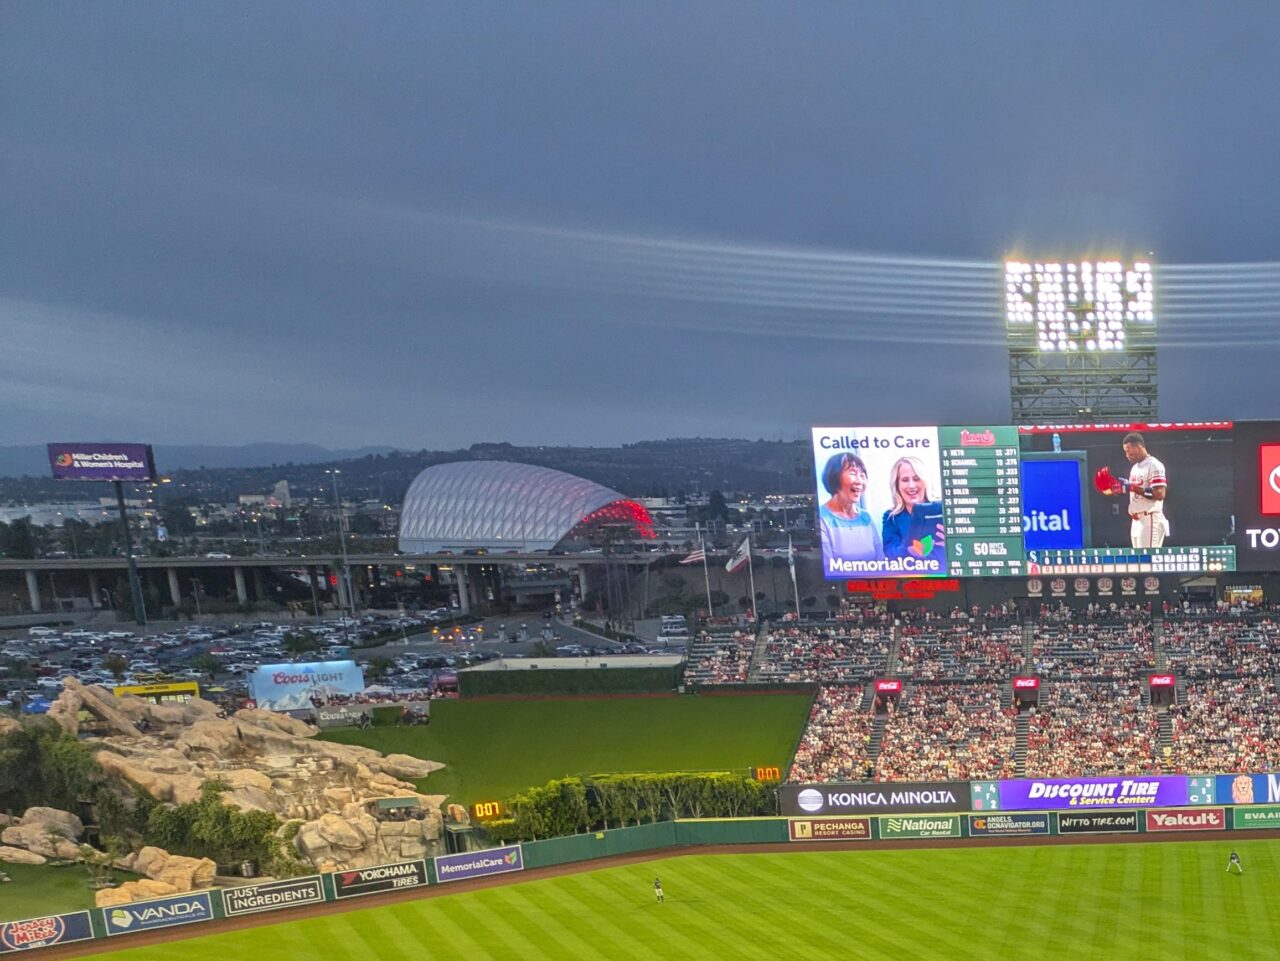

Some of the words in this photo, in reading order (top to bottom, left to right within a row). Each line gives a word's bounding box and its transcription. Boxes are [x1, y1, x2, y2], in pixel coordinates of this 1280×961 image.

[820, 436, 869, 449] Called
[874, 437, 890, 448] to
[894, 435, 930, 448] Care
[93, 453, 128, 461] Children's
[114, 461, 144, 469] Hospital
[973, 542, 988, 555] 50
[829, 557, 939, 572] MemorialCare
[1081, 556, 1087, 564] 2
[1031, 580, 1039, 590] 11
[1077, 580, 1087, 589] 29
[1100, 580, 1110, 588] 30
[1123, 580, 1134, 588] 42
[272, 671, 310, 685] Coors
[310, 672, 344, 683] LIGHT
[757, 767, 779, 779] 0:07
[989, 785, 996, 793] 4
[1205, 779, 1212, 788] 3
[1029, 782, 1117, 799] DISCOUNT
[1120, 781, 1160, 795] TIRE
[828, 792, 888, 806] KONICA
[890, 790, 957, 805] MINOLTA
[990, 799, 997, 809] 2
[1069, 797, 1076, 806] &
[1077, 796, 1116, 805] Service
[1117, 796, 1156, 804] Centers
[1190, 795, 1199, 803] C
[1206, 794, 1212, 804] 3
[475, 802, 499, 816] 0:07
[902, 819, 953, 831] National
[987, 821, 1045, 830] OCNAVIGATOR.ORG
[1061, 817, 1090, 828] NITTO
[1092, 816, 1135, 827] TIRE.COM
[1152, 813, 1219, 827] Yakult
[814, 822, 865, 831] PECHANGA
[440, 856, 504, 874] MemorialCare
[359, 863, 418, 881] YOKOHAMA
[392, 876, 419, 888] TIRES
[232, 887, 259, 898] JUST
[233, 887, 316, 910] INGREDIENTS
[132, 900, 205, 921] VANDA
[10, 918, 55, 934] Jersey
[14, 928, 58, 946] Mike's
